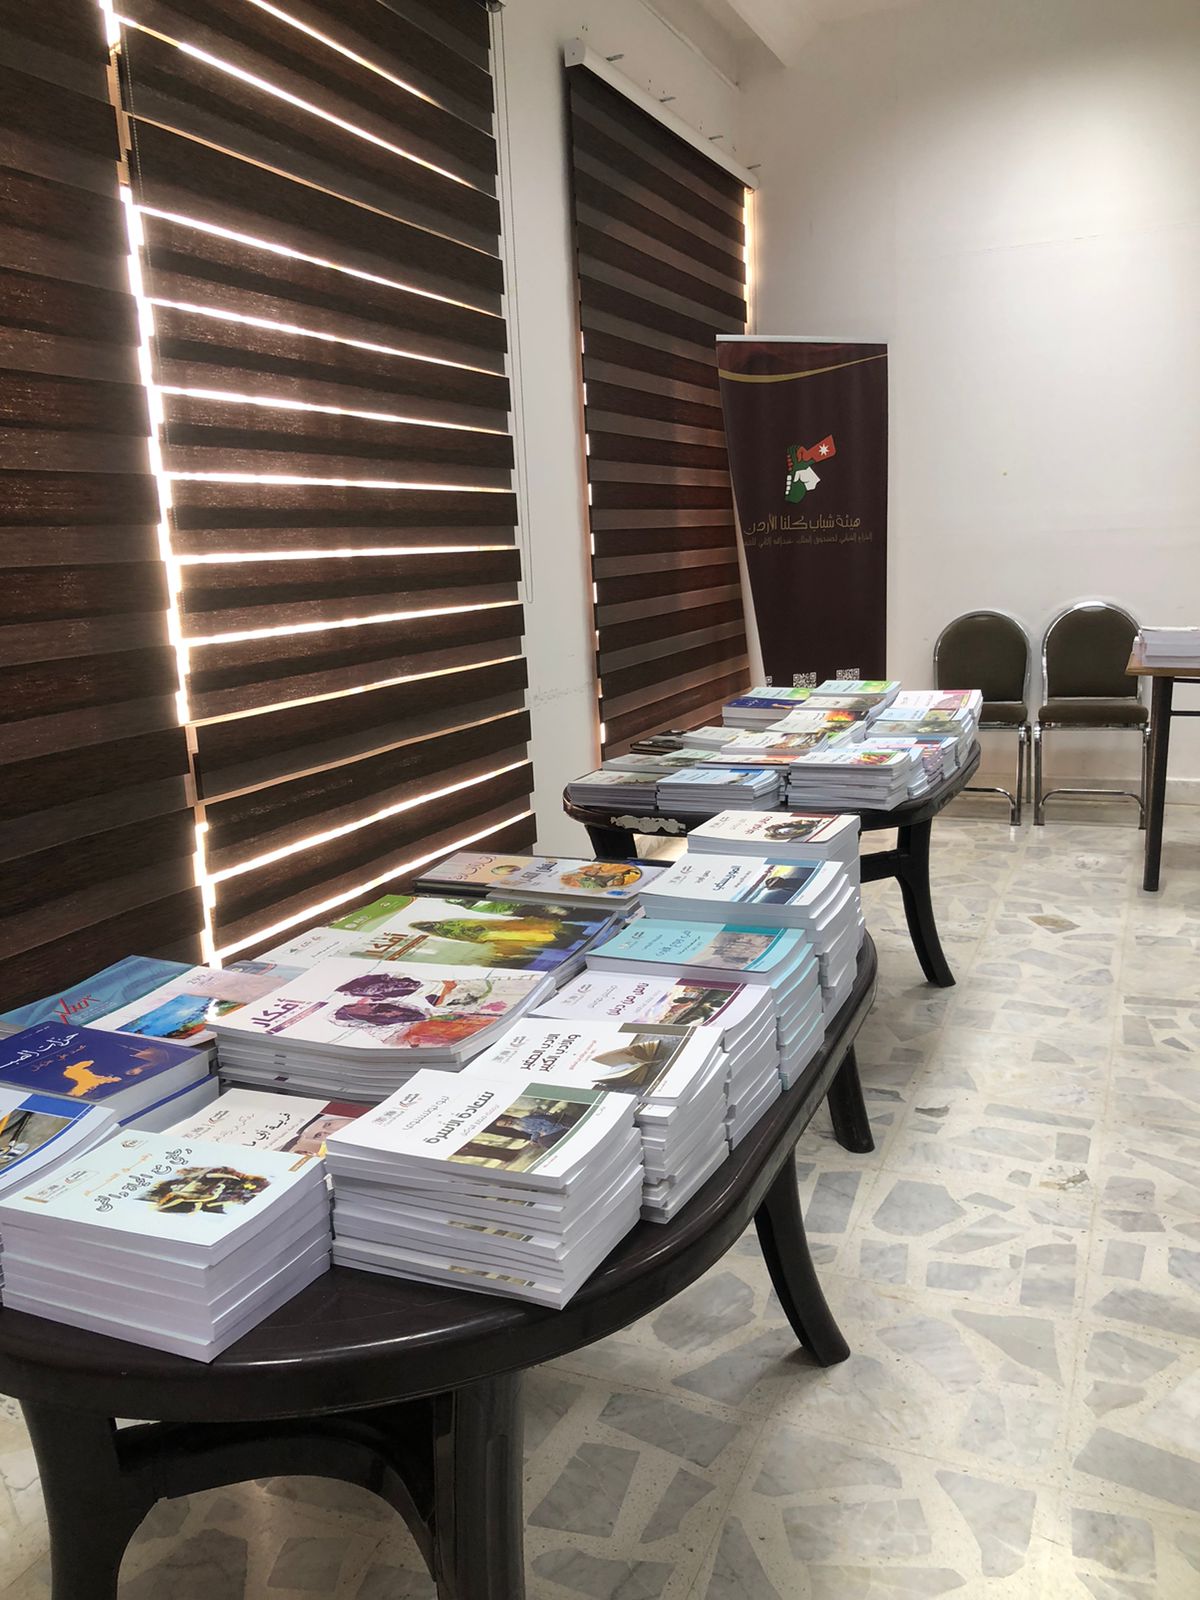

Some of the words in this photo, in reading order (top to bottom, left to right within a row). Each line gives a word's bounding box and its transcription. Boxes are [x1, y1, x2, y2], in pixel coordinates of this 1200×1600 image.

[744, 512, 777, 535] الأردن
[780, 515, 808, 530] كلنا
[809, 514, 835, 532] شباب
[835, 514, 861, 530] هيئة
[251, 998, 307, 1029] أفكار
[422, 1118, 465, 1145] الأسرة
